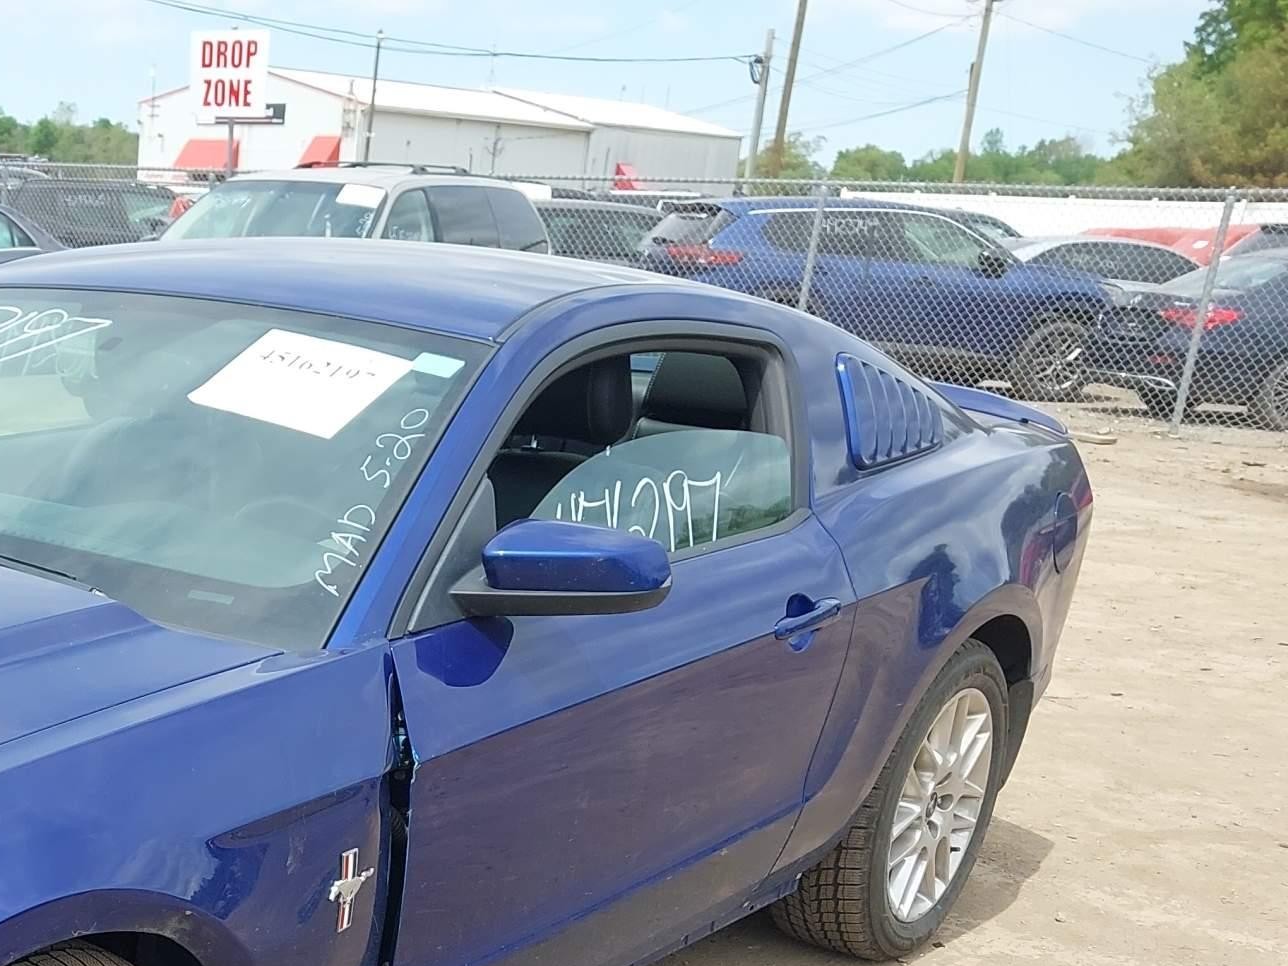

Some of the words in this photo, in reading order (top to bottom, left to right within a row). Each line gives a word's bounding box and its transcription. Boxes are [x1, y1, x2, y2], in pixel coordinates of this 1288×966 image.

[201, 40, 258, 68] DROP
[203, 79, 252, 107] ZONE
[314, 504, 376, 597] MAD
